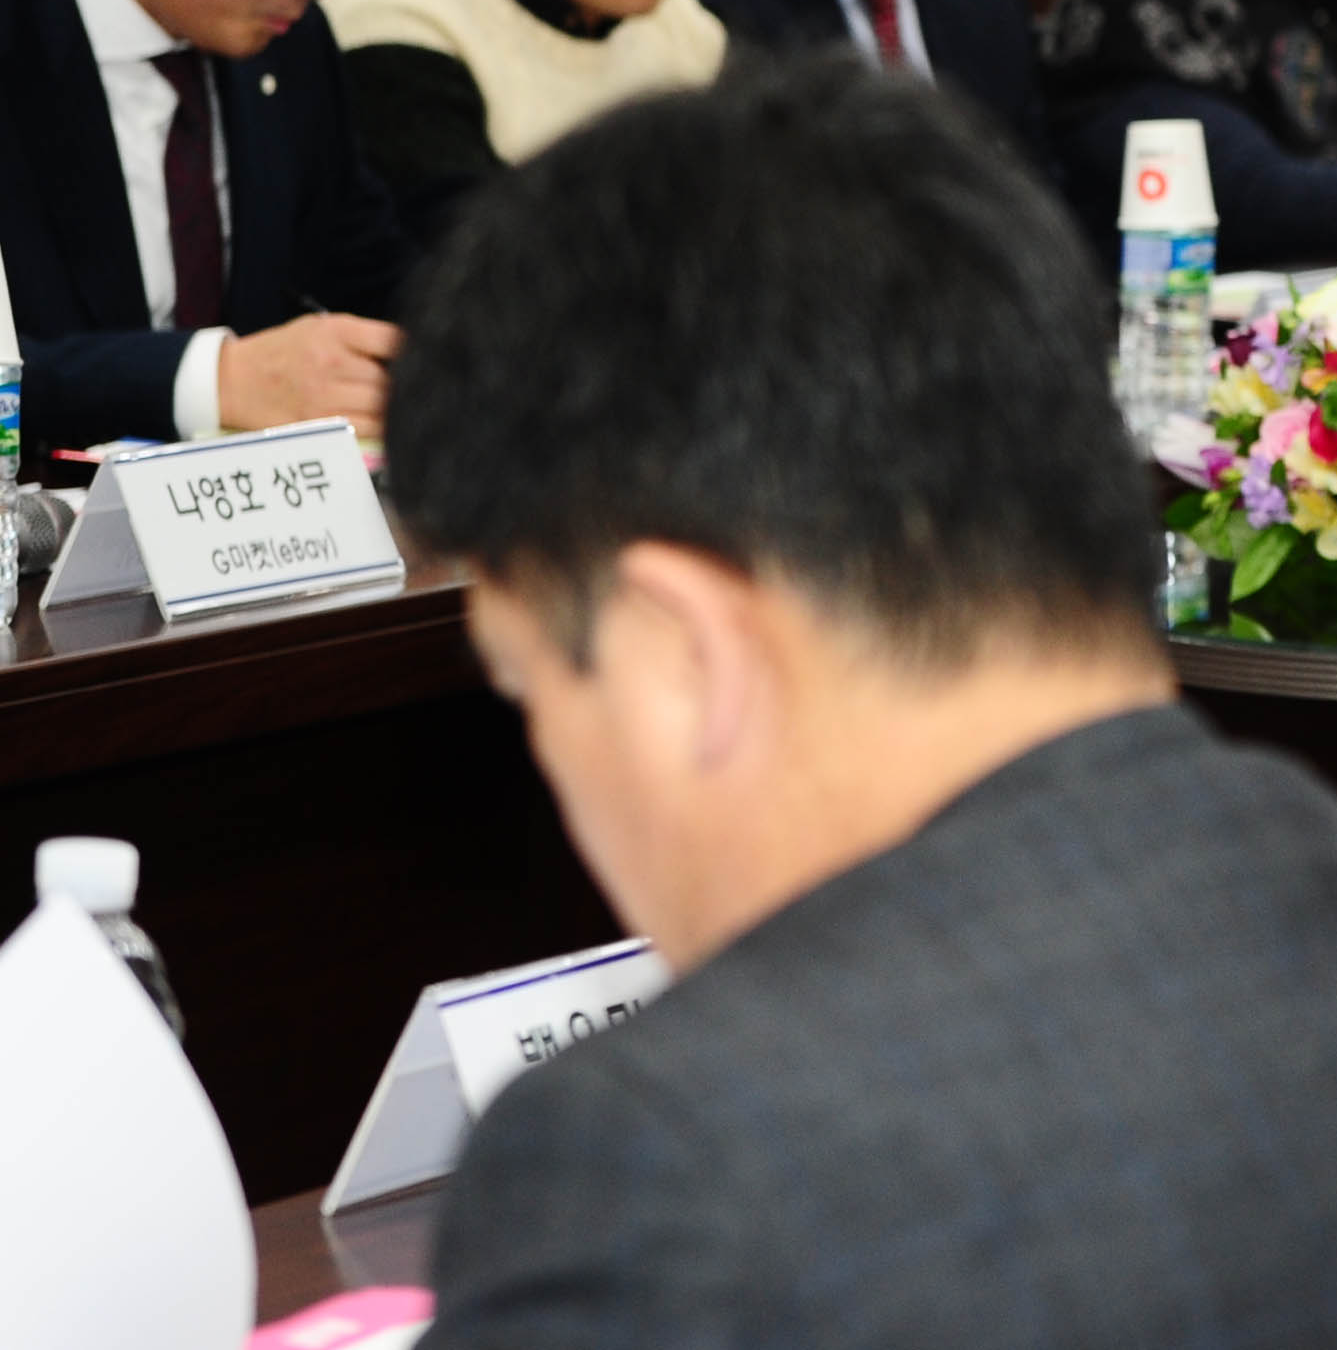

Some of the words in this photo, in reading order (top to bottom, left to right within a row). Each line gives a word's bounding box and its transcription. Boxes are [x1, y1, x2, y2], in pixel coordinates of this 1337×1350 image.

[167, 470, 265, 521] 나영호
[273, 460, 330, 508] 상무
[211, 529, 339, 575] G마켓(eBay)
